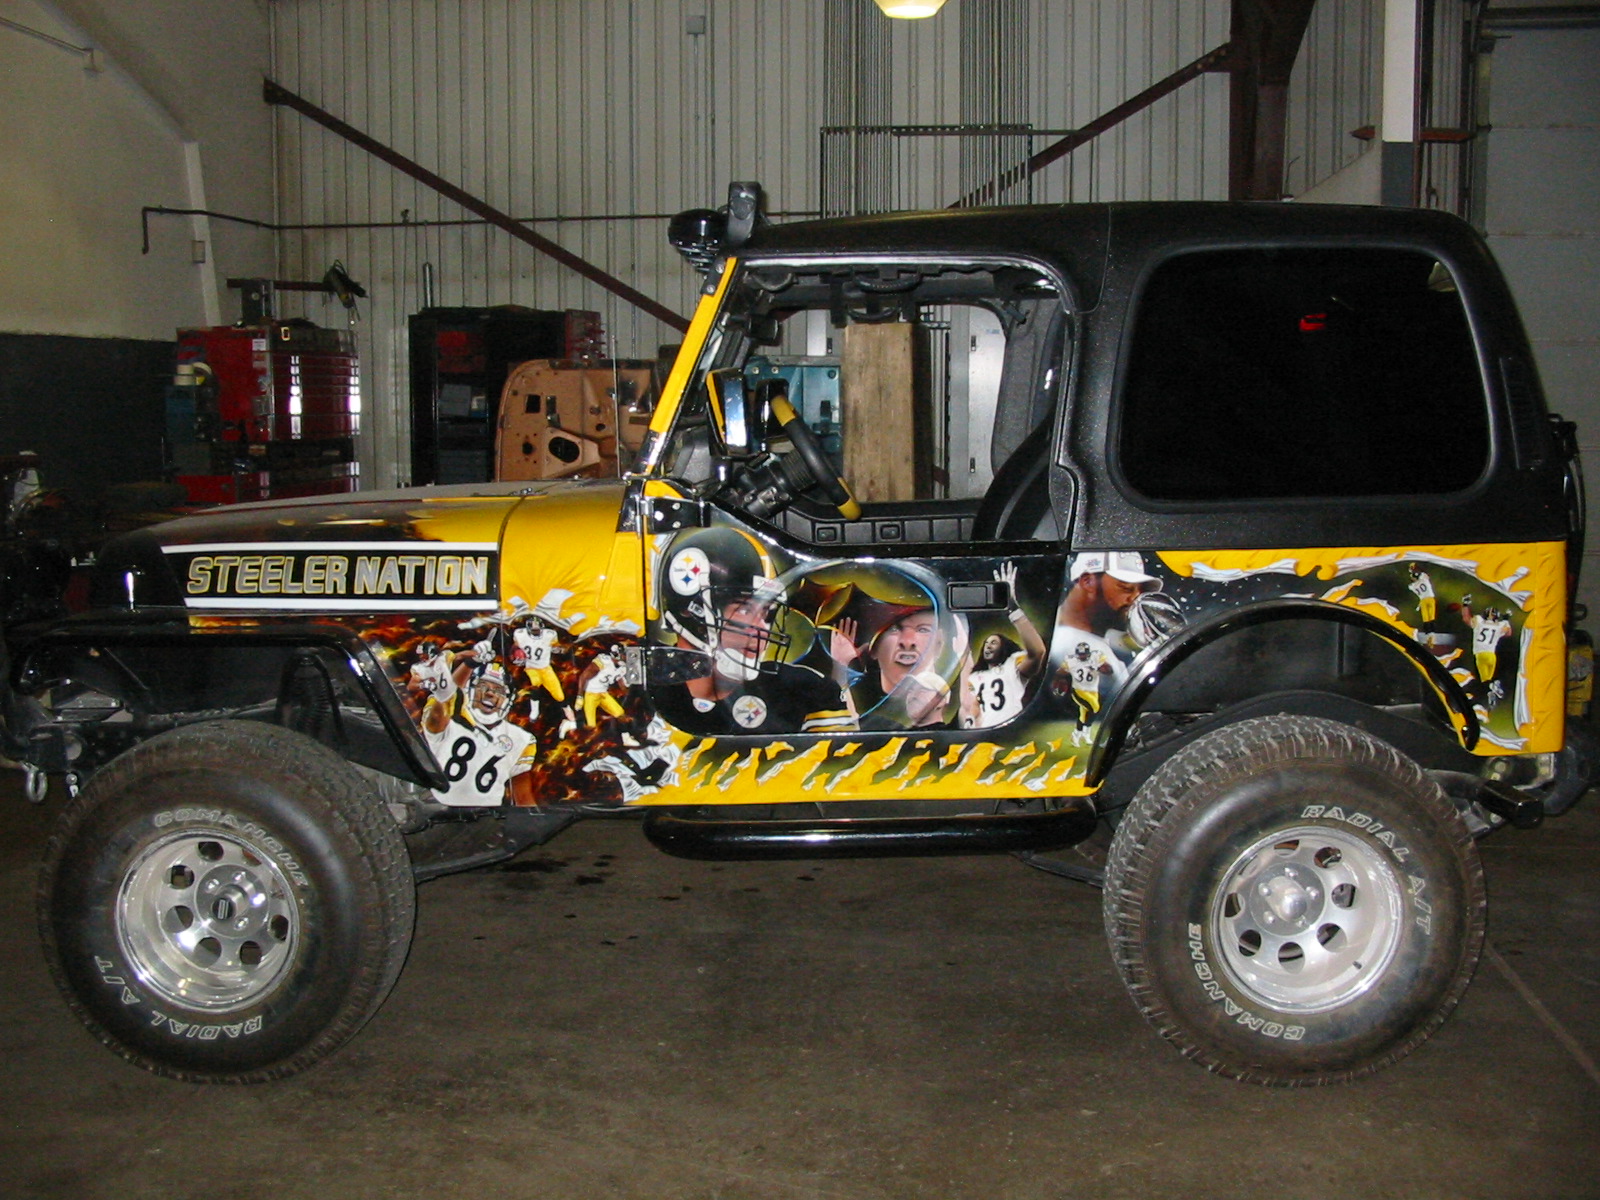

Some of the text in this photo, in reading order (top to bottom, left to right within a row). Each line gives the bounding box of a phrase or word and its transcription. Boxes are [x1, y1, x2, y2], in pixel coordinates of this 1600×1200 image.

[187, 556, 489, 596] STEELER NATION
[1477, 629, 1497, 644] 51
[1074, 667, 1094, 682] 36
[444, 735, 505, 793] 86
[153, 807, 309, 886] COMANCHE
[1301, 804, 1433, 935] RADIAL A/T
[94, 954, 263, 1040] RADIAL A/T
[1187, 922, 1306, 1041] COMANCHE
